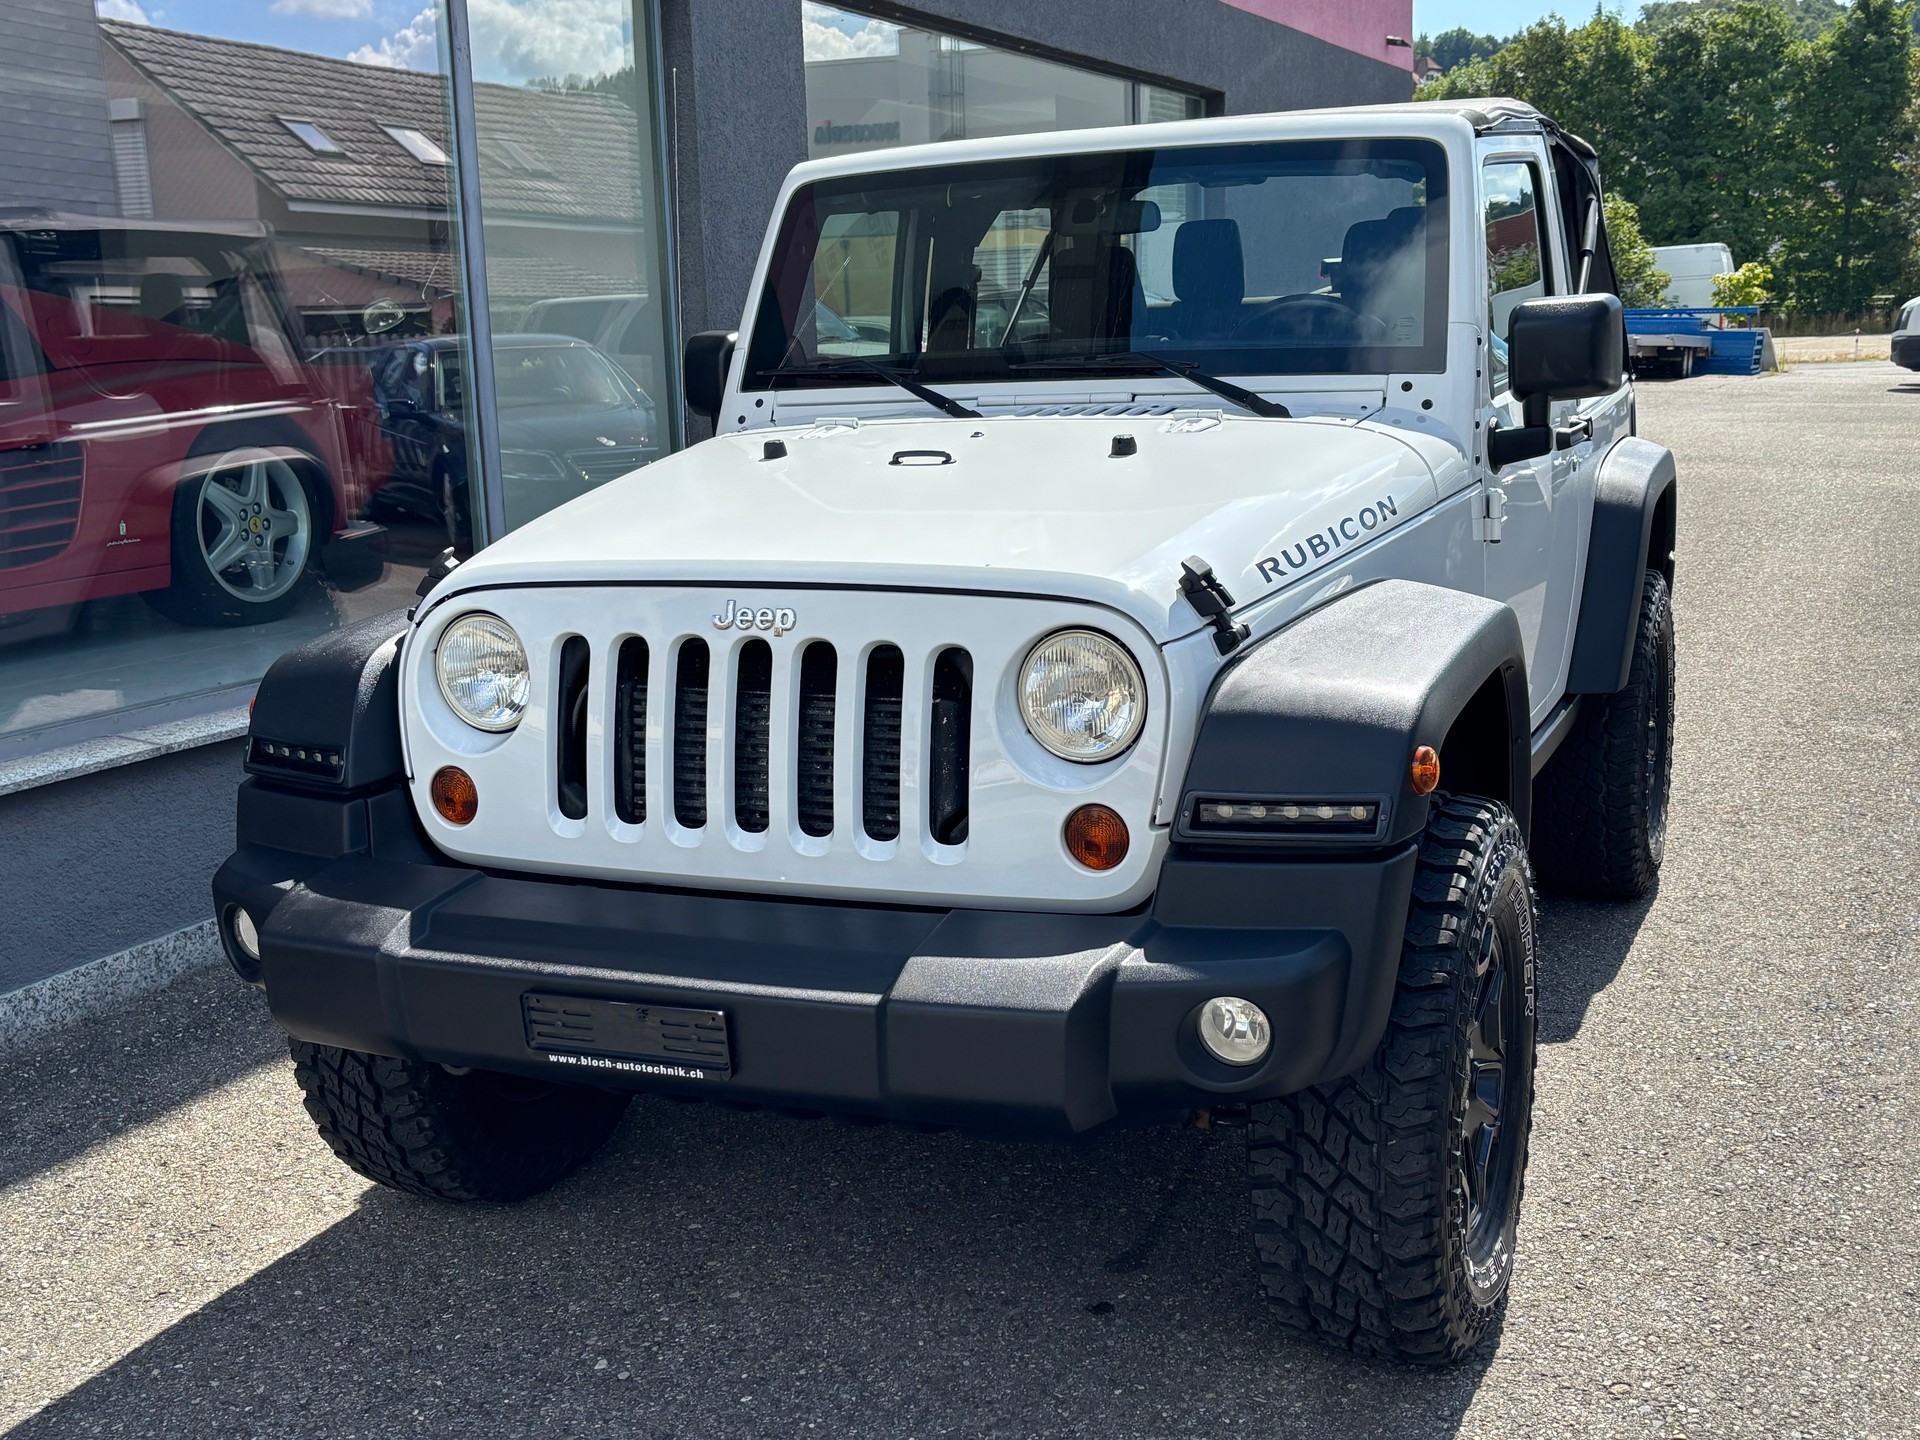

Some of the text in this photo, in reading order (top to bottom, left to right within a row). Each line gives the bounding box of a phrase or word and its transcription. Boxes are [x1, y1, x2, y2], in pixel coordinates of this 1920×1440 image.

[1255, 495, 1398, 584] RUBICON
[711, 599, 797, 638] Jeep
[1508, 879, 1535, 1017] COOPER
[548, 1053, 704, 1079] www.bloch-autotechnik.ch
